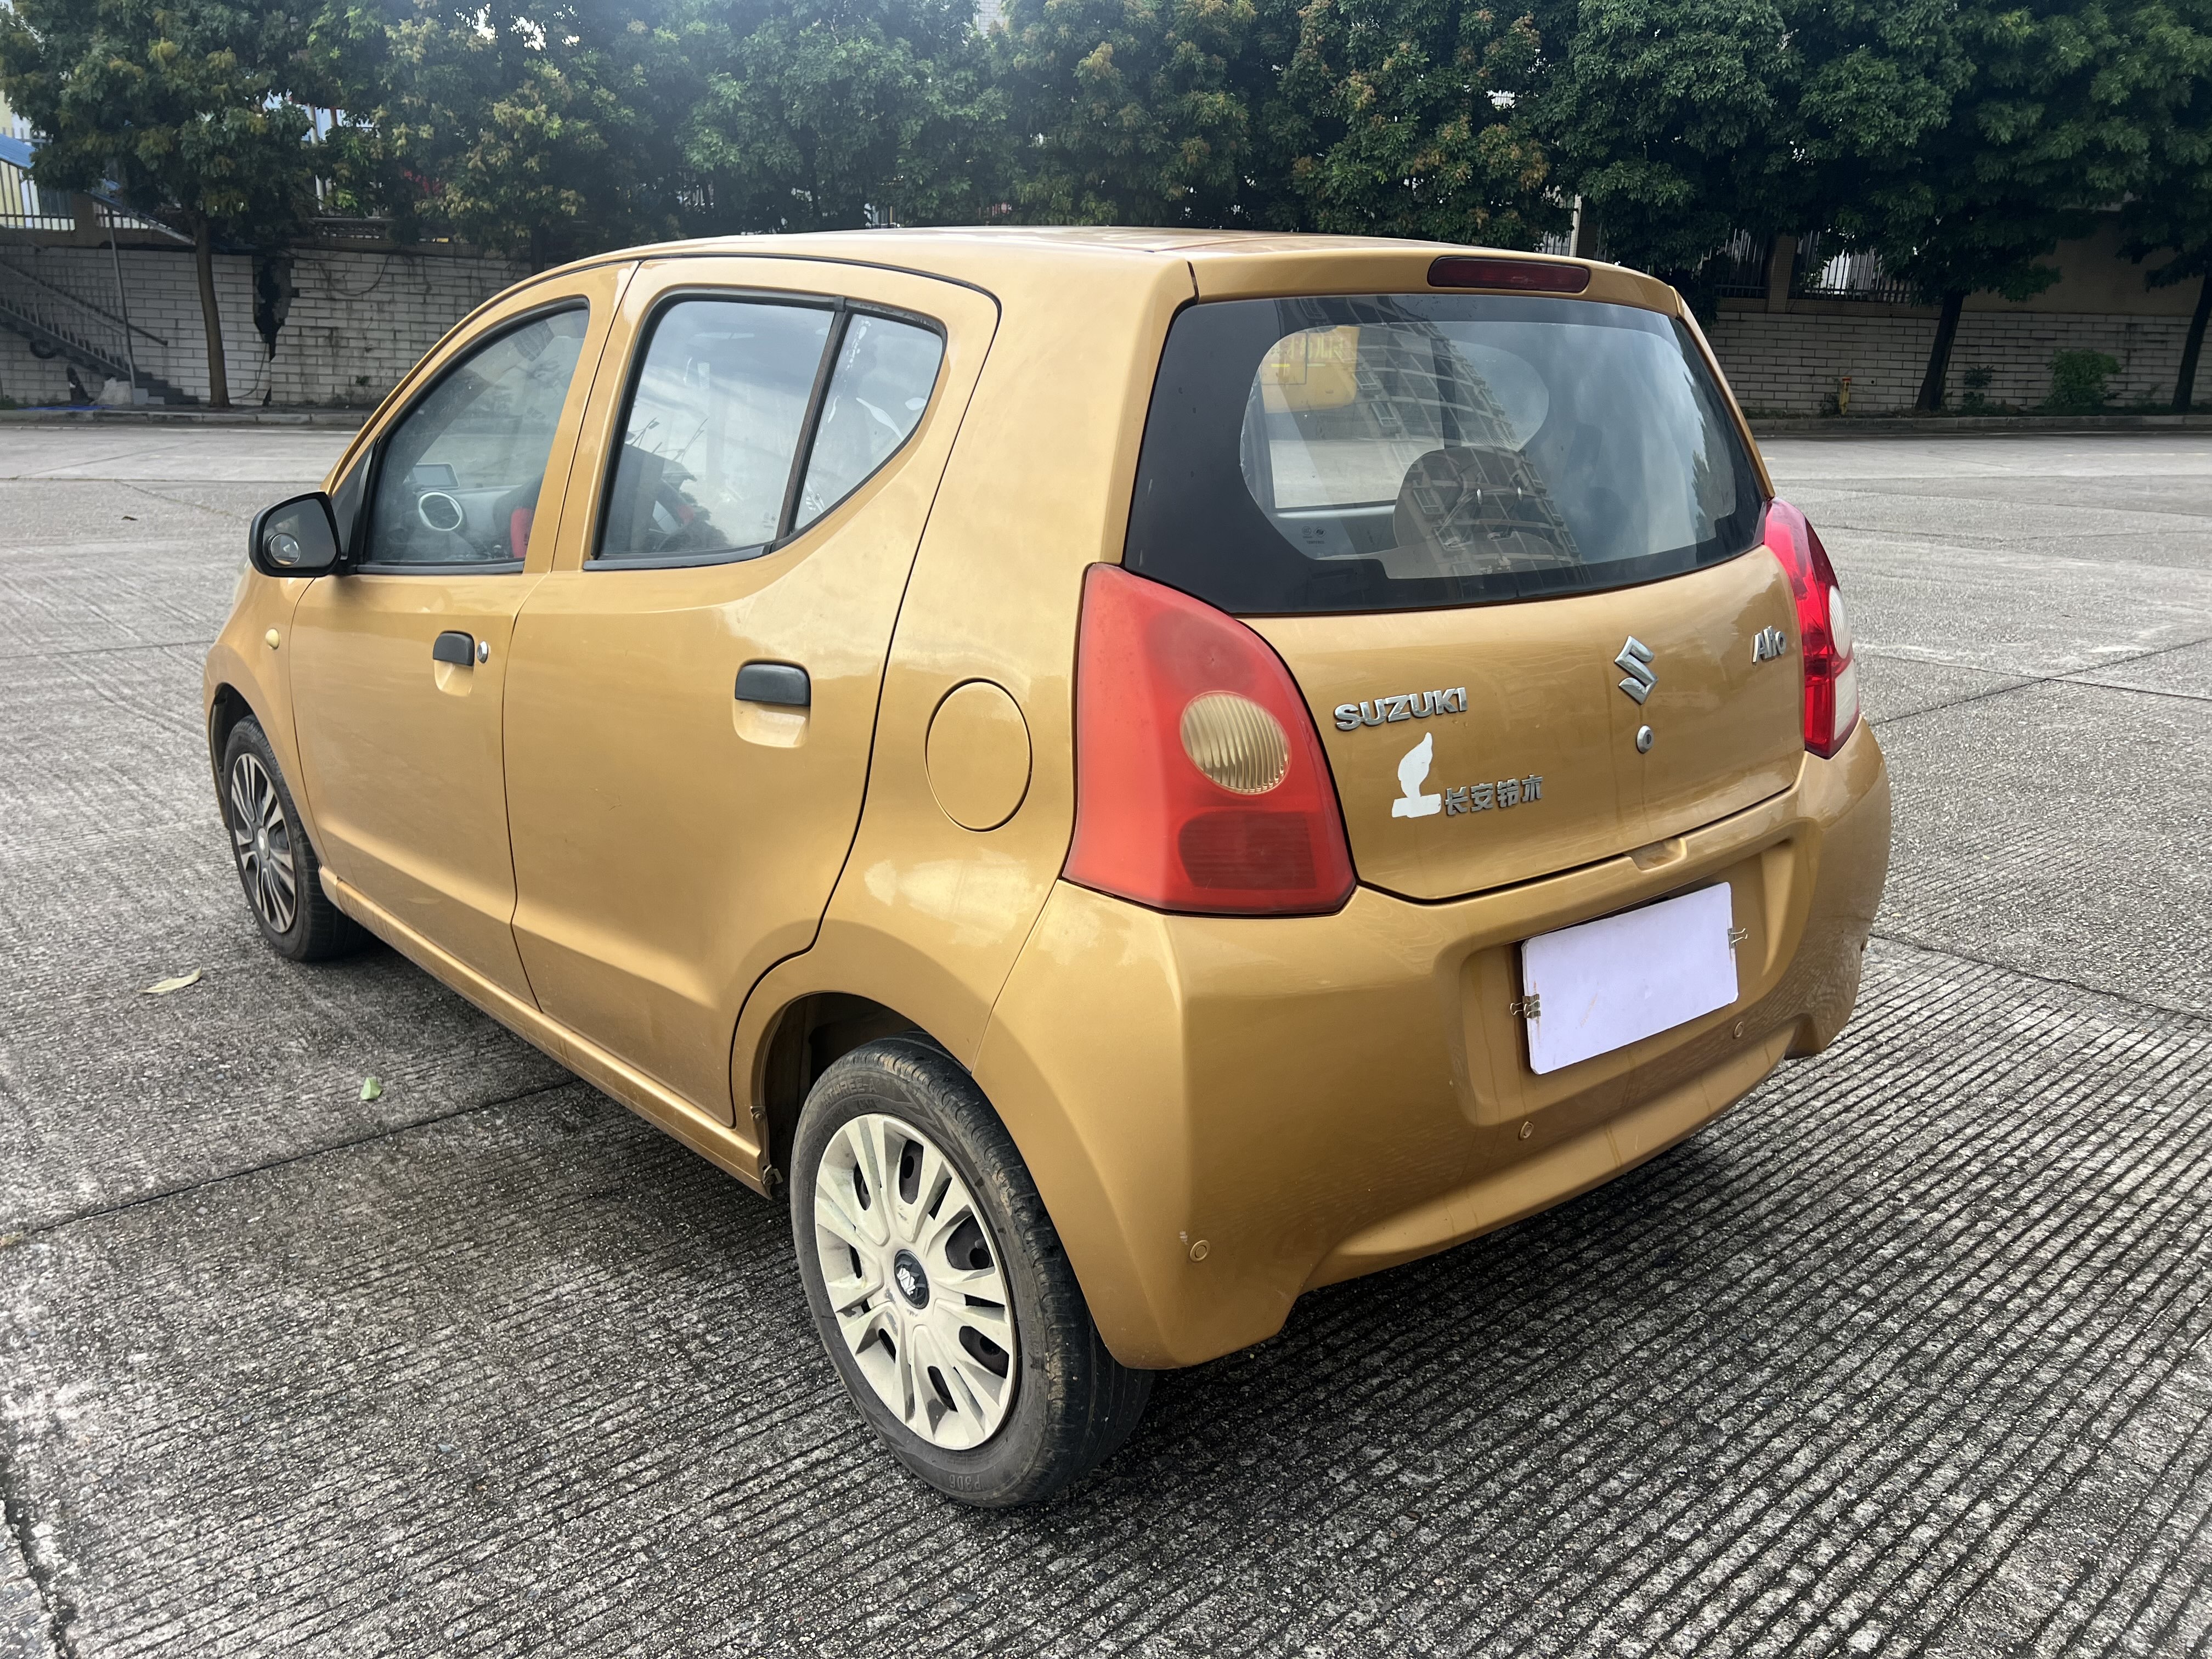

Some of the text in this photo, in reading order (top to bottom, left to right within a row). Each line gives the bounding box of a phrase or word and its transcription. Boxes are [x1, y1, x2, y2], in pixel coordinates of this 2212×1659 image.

[1752, 625, 1787, 663] Alto
[1334, 687, 1468, 731] SUZUKI
[1445, 774, 1543, 816] 长安铃木
